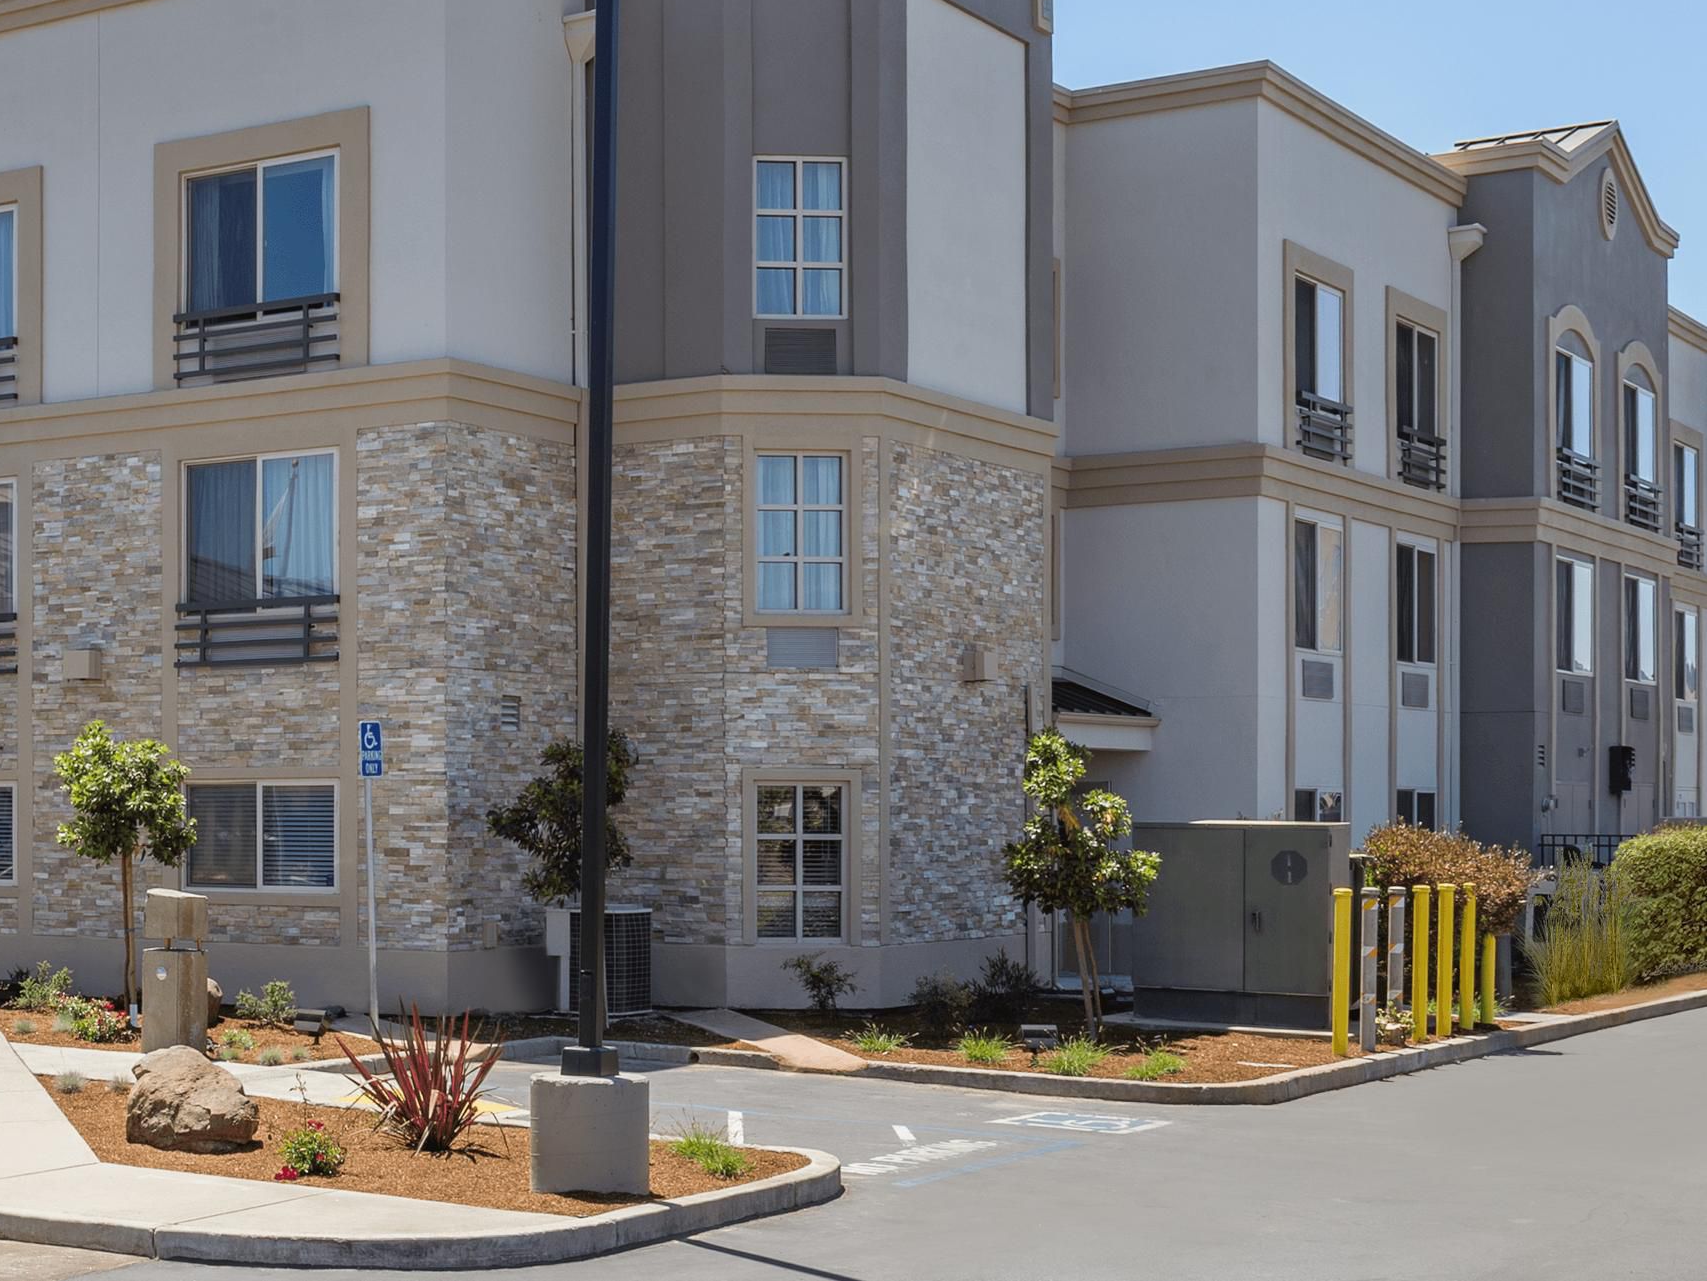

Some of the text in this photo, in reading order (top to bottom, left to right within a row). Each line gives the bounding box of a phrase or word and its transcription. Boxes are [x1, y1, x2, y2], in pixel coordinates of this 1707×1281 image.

[362, 750, 383, 761] PARKING
[365, 763, 379, 774] ONLY
[869, 1139, 997, 1165] PARKING
